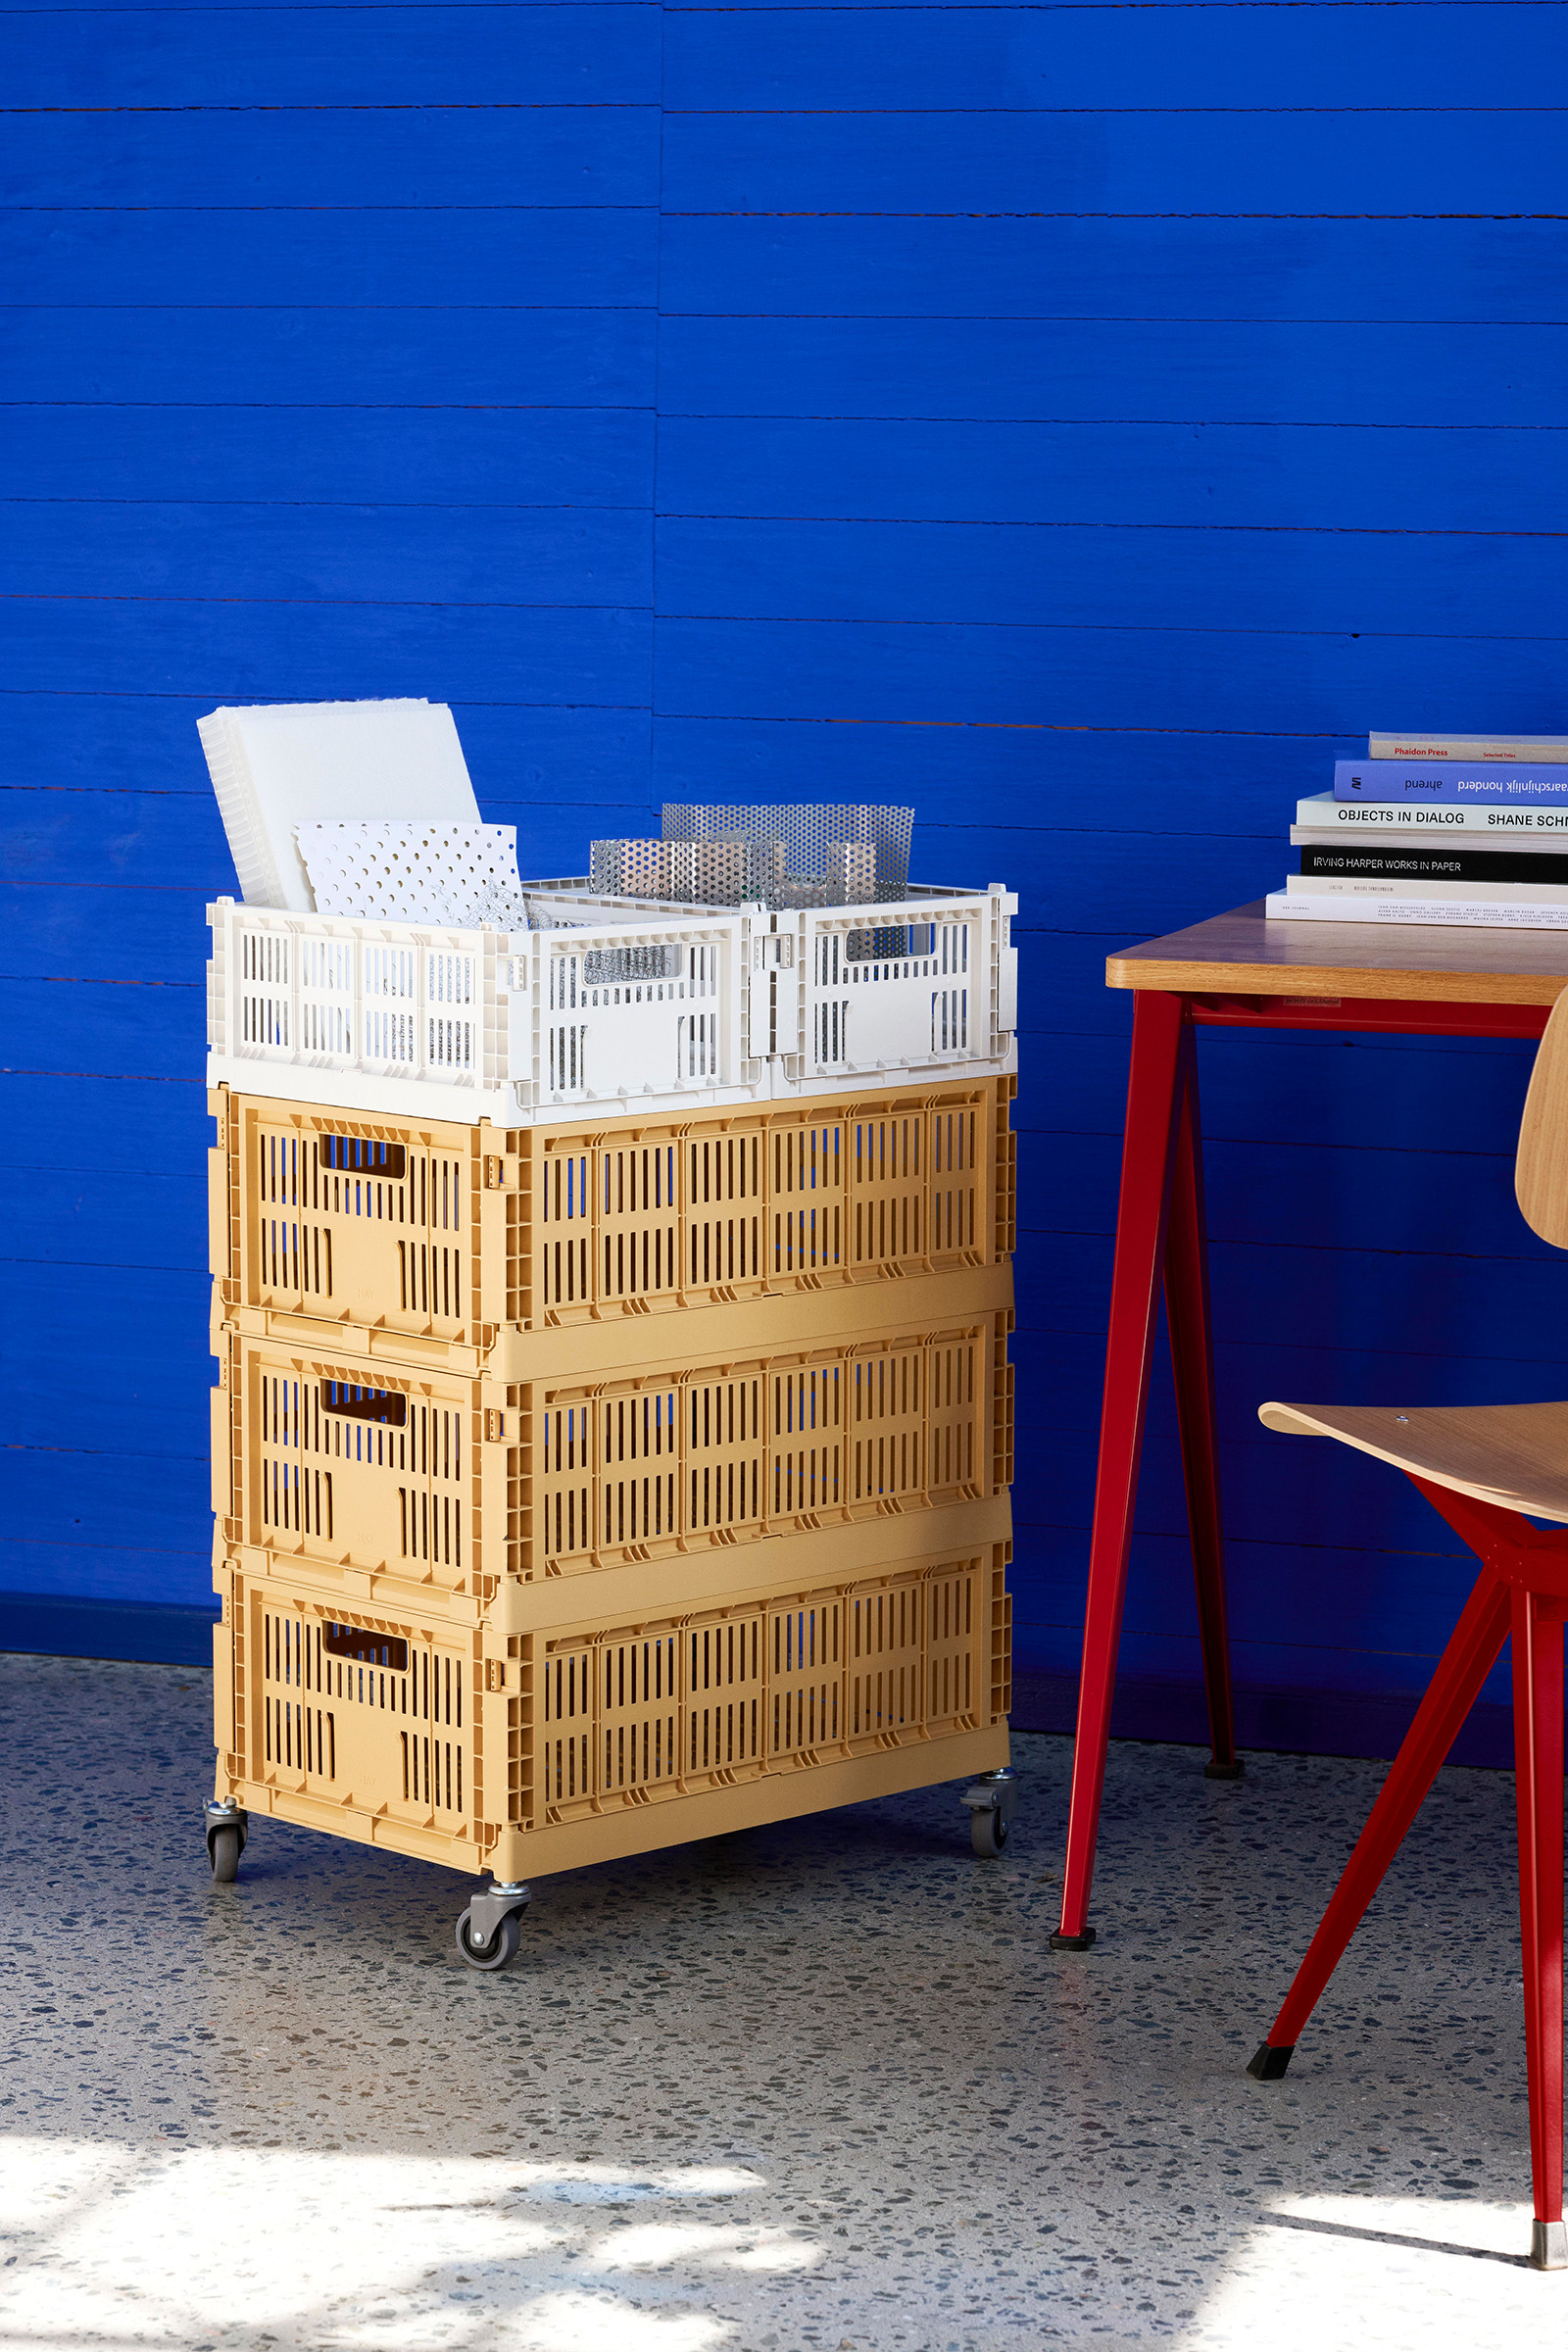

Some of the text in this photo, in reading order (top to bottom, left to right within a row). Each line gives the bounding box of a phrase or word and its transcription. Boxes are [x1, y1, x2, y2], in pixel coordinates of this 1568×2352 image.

[1404, 780, 1443, 791] ahrend
[1457, 779, 1568, 794] aarschijnlijk honderd
[1338, 809, 1464, 823] OBJECTS IN DIALOG
[1488, 814, 1533, 826] SHANE
[1313, 857, 1461, 871] IRVING HARPER WORKS IN PAPER
